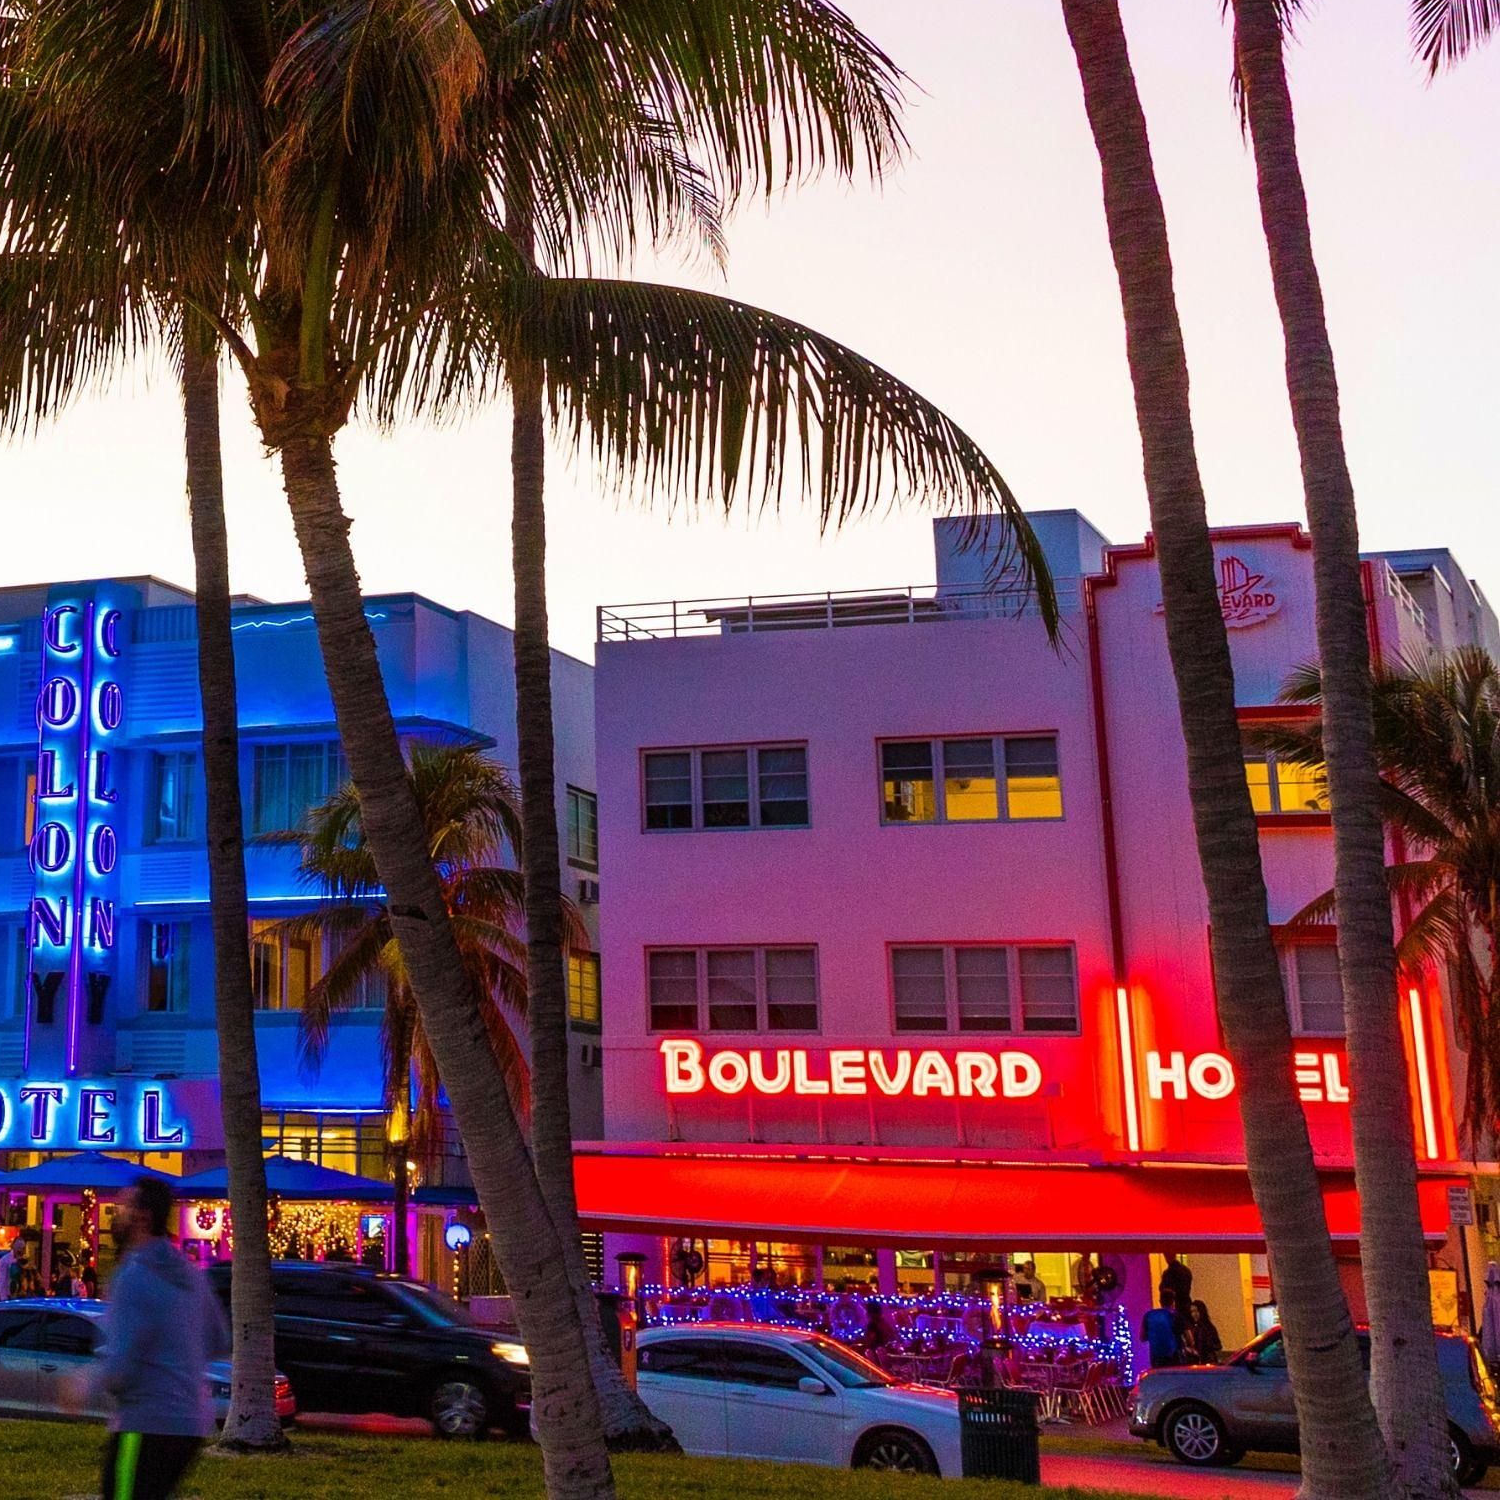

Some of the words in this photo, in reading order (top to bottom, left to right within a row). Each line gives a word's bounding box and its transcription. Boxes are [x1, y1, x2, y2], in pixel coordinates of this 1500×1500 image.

[1220, 592, 1276, 610] EVARD
[29, 603, 79, 1025] COLONY
[86, 610, 123, 1025] COLONY
[660, 1039, 1042, 1098] BOULEVARD
[1145, 1051, 1349, 1102] HOEL
